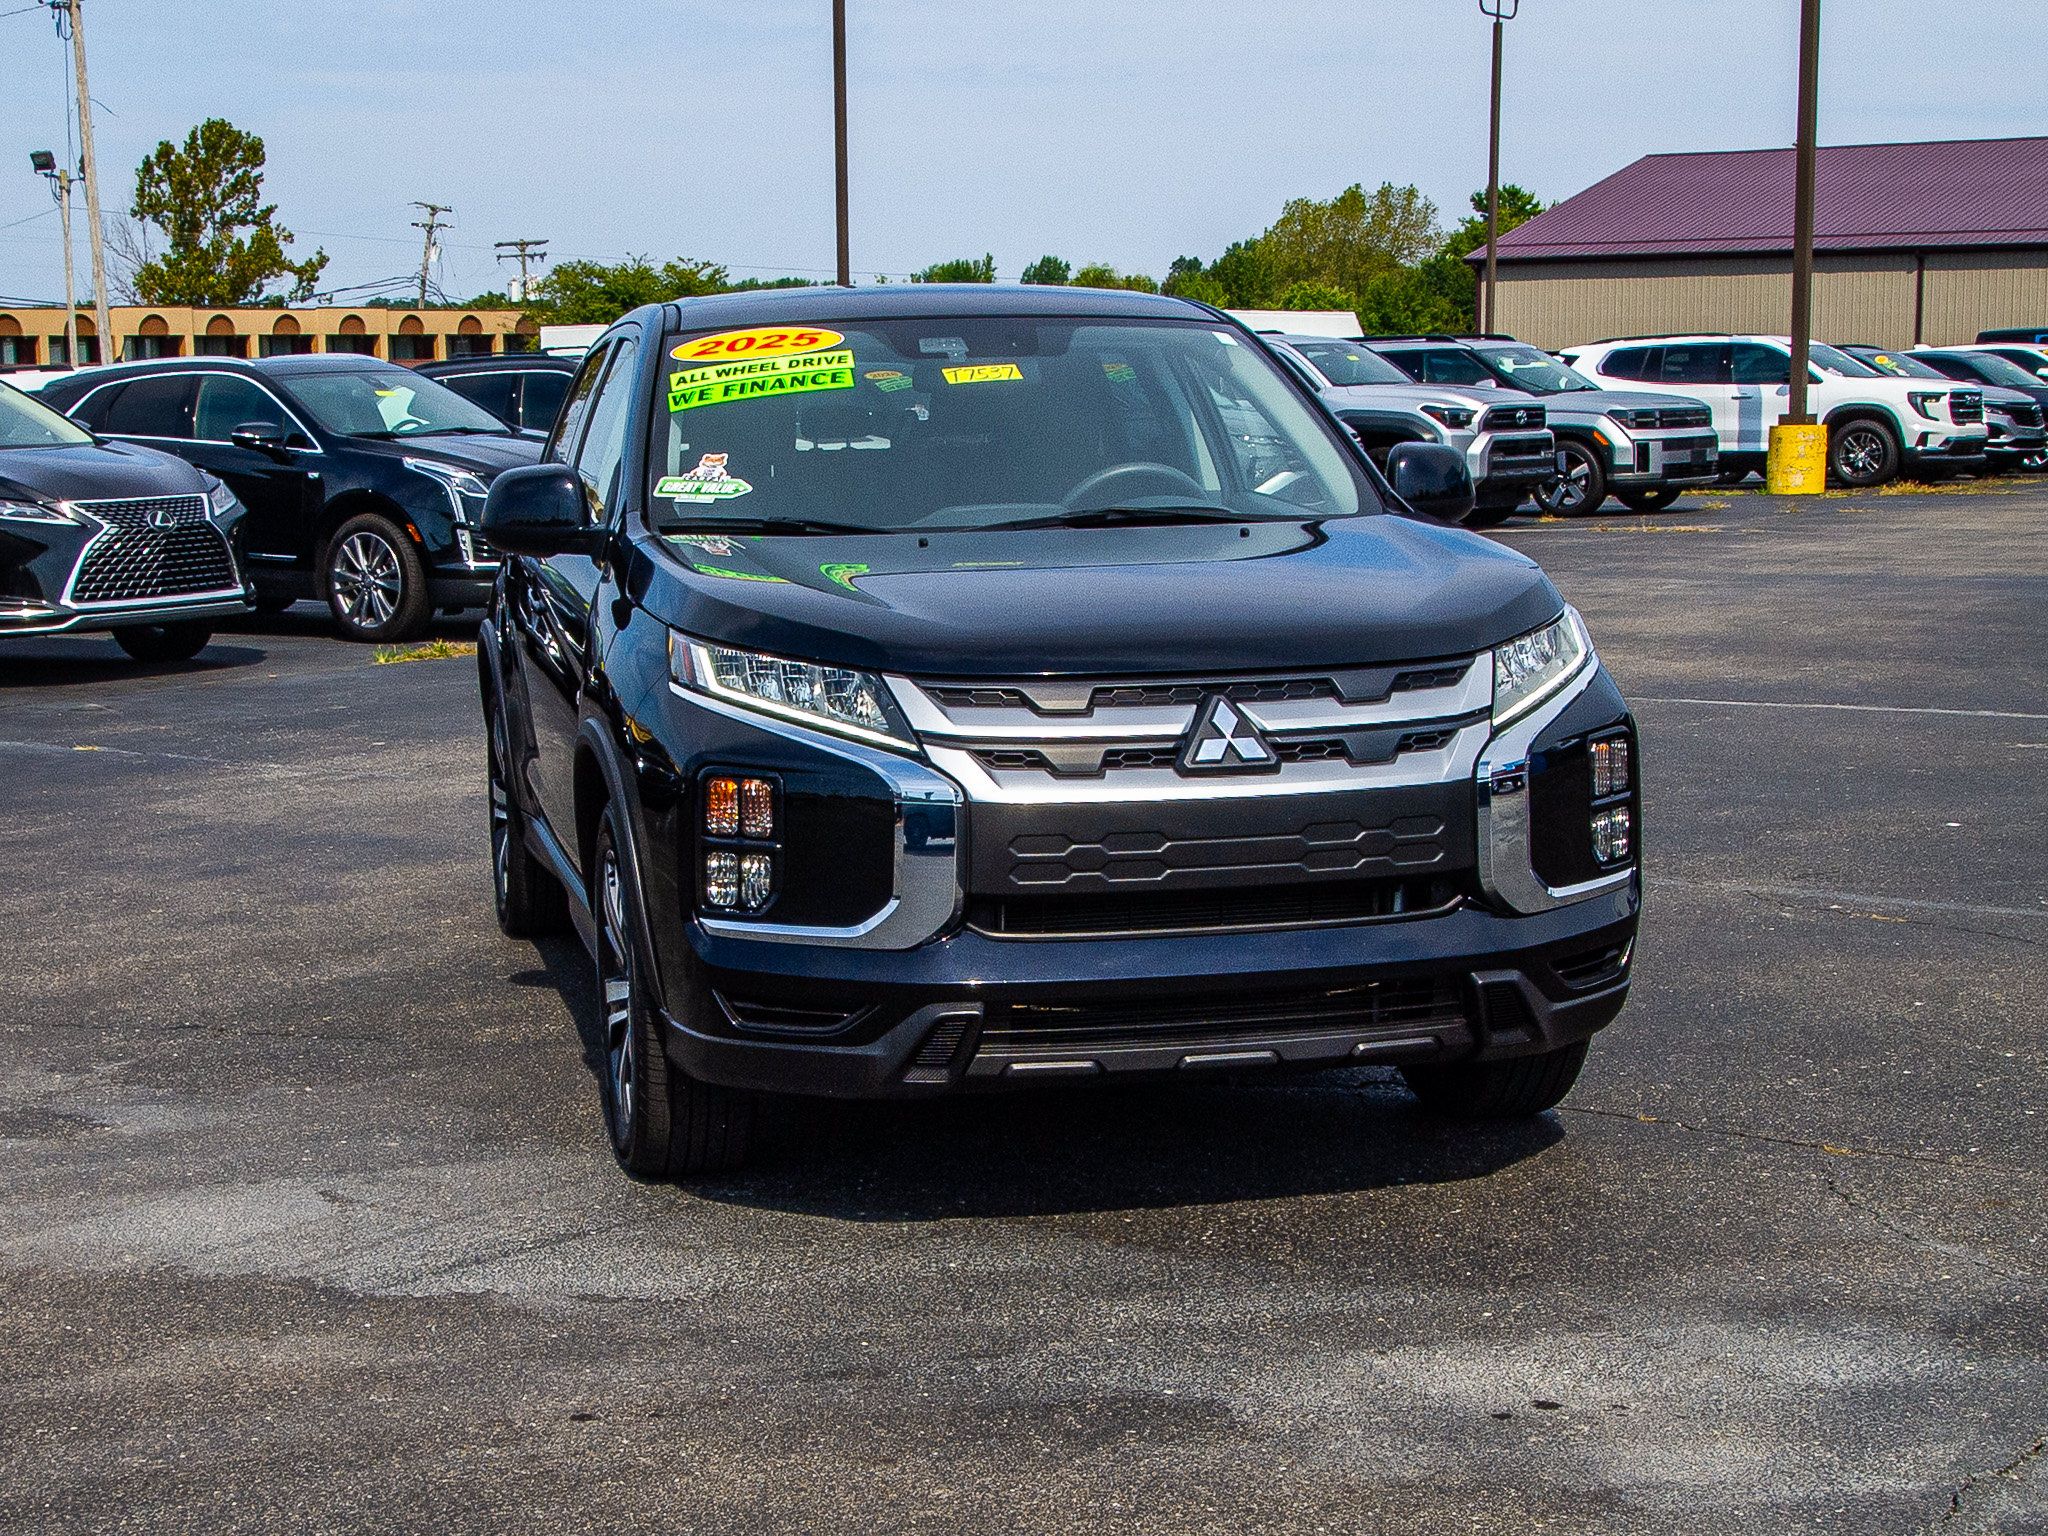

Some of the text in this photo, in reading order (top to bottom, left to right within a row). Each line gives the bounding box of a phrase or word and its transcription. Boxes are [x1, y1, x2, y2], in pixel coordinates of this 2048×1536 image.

[691, 332, 822, 357] 2025
[676, 355, 848, 386] ALL WHEEL DRIVE
[946, 366, 1013, 383] T7537
[672, 371, 845, 406] WE FINANCE
